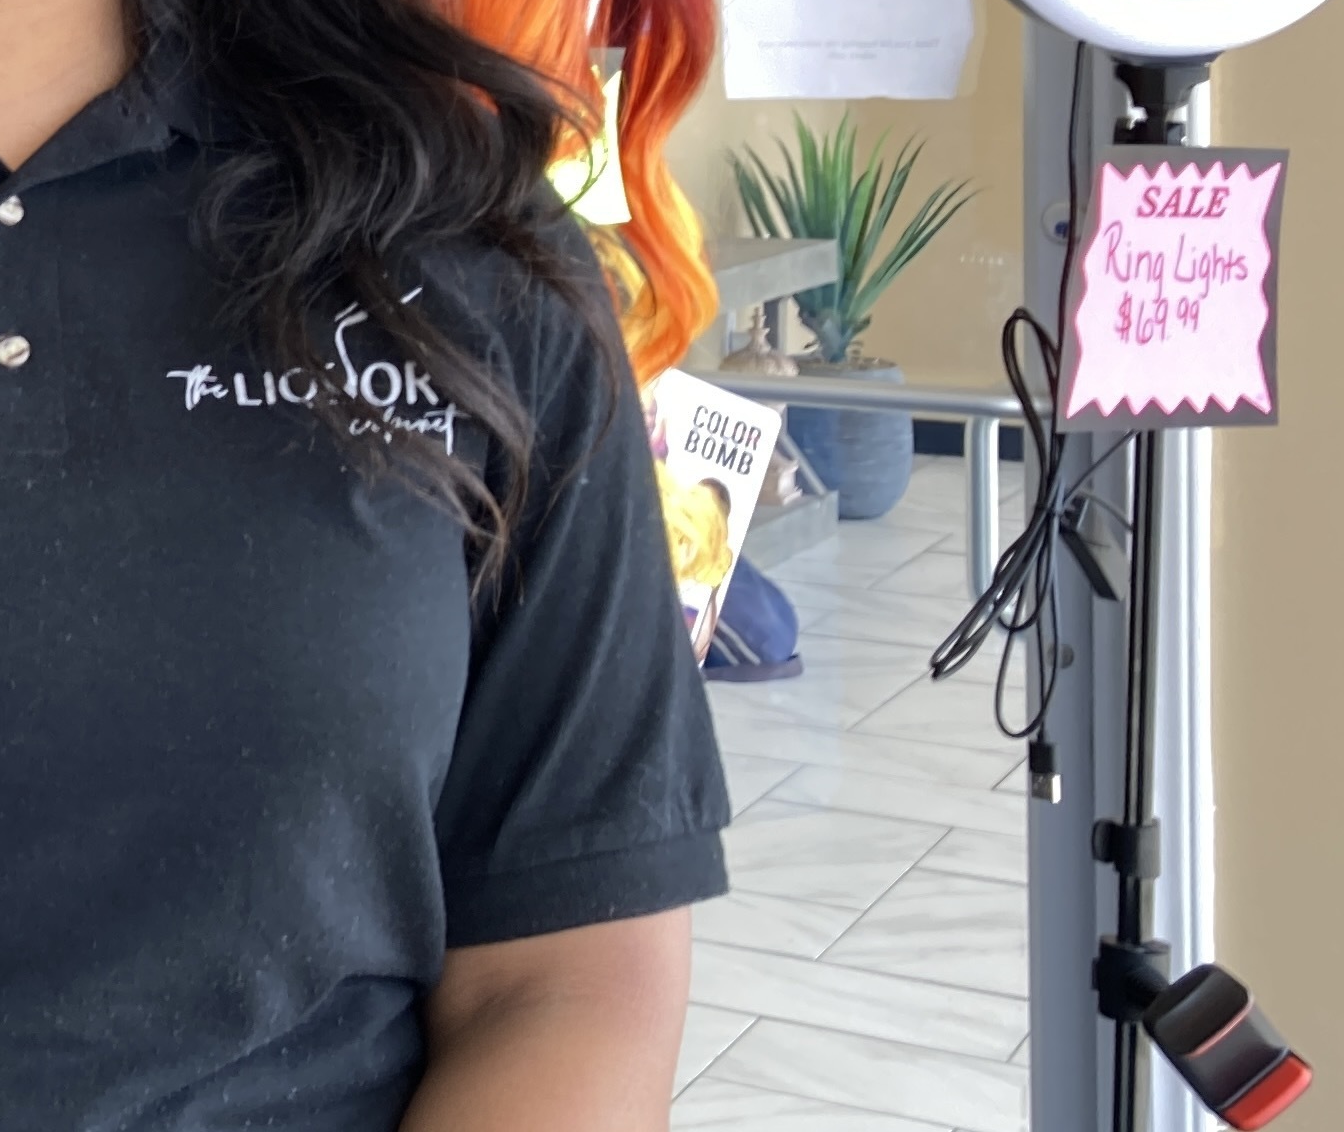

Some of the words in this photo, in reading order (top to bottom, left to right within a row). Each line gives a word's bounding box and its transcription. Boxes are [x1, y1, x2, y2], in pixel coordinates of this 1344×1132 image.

[1136, 185, 1231, 218] SALE
[1103, 220, 1164, 301] Ring
[1173, 233, 1249, 299] Lights
[693, 404, 762, 452] COLOR
[683, 429, 754, 476] BOMB
